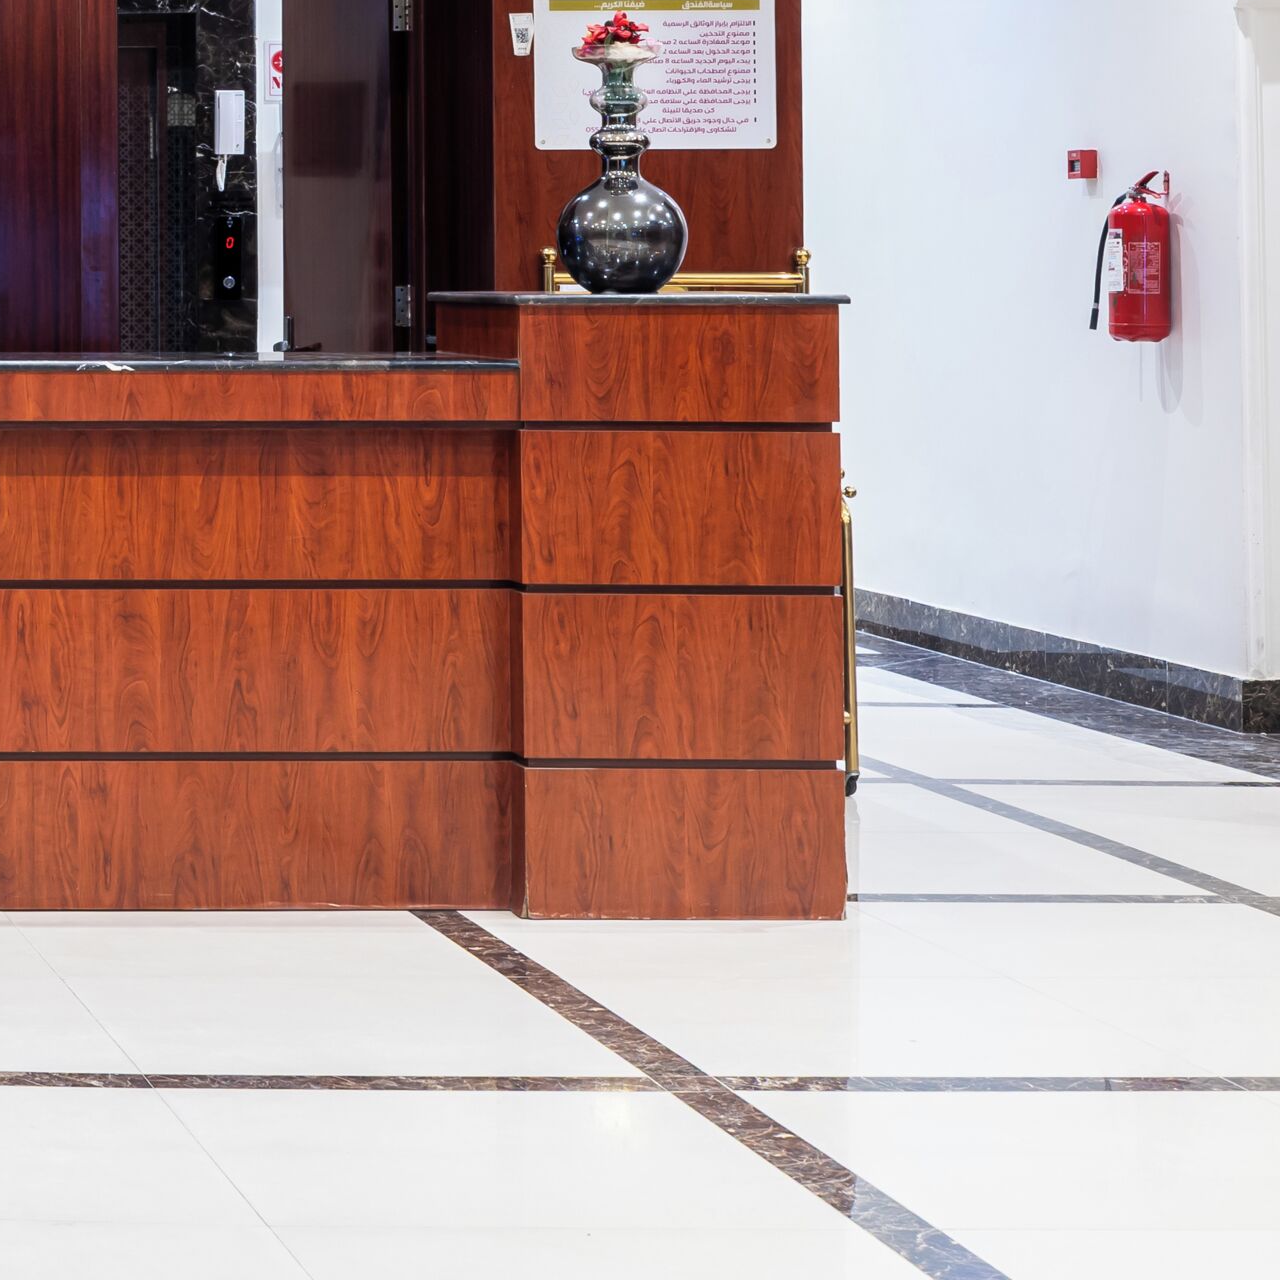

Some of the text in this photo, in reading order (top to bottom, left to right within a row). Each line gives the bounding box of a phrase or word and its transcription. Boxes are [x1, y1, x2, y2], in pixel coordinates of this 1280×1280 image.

[624, 0, 645, 9] ضيفنا
[727, 68, 750, 76] ممنوع
[225, 236, 234, 249] 0
